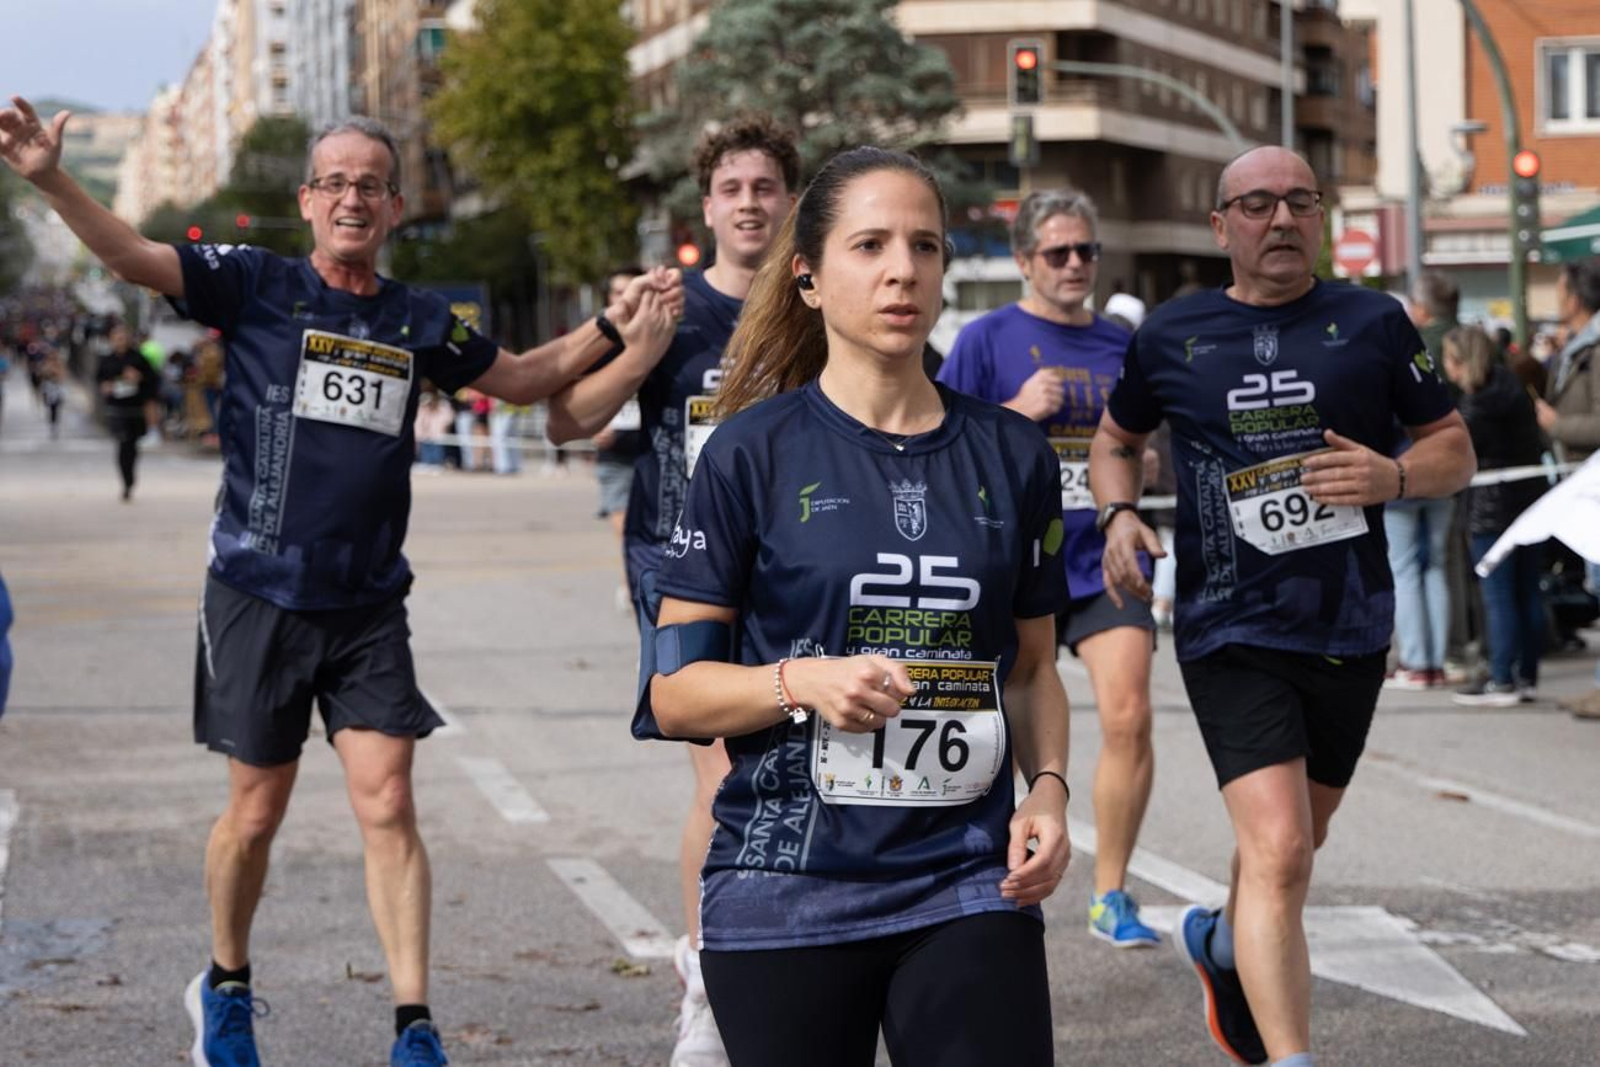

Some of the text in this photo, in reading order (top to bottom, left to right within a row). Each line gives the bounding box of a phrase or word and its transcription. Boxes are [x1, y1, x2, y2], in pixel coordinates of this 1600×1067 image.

[267, 384, 290, 403] IES
[323, 371, 384, 410] 631
[1227, 369, 1316, 411] 25
[1228, 406, 1318, 423] CARRERA
[1231, 416, 1320, 434] POPULAR
[1230, 471, 1257, 492] XXV
[1260, 493, 1335, 532] 692
[263, 512, 276, 537] DE
[850, 553, 981, 611] 25
[849, 608, 971, 628] CARRERA
[848, 626, 972, 647] POPULAR
[905, 648, 972, 660] caminata
[907, 668, 989, 681] RERA POPULAR
[938, 681, 990, 692] caminata
[872, 720, 970, 773] 176
[744, 797, 783, 868] SANTA
[774, 840, 799, 870] DE
